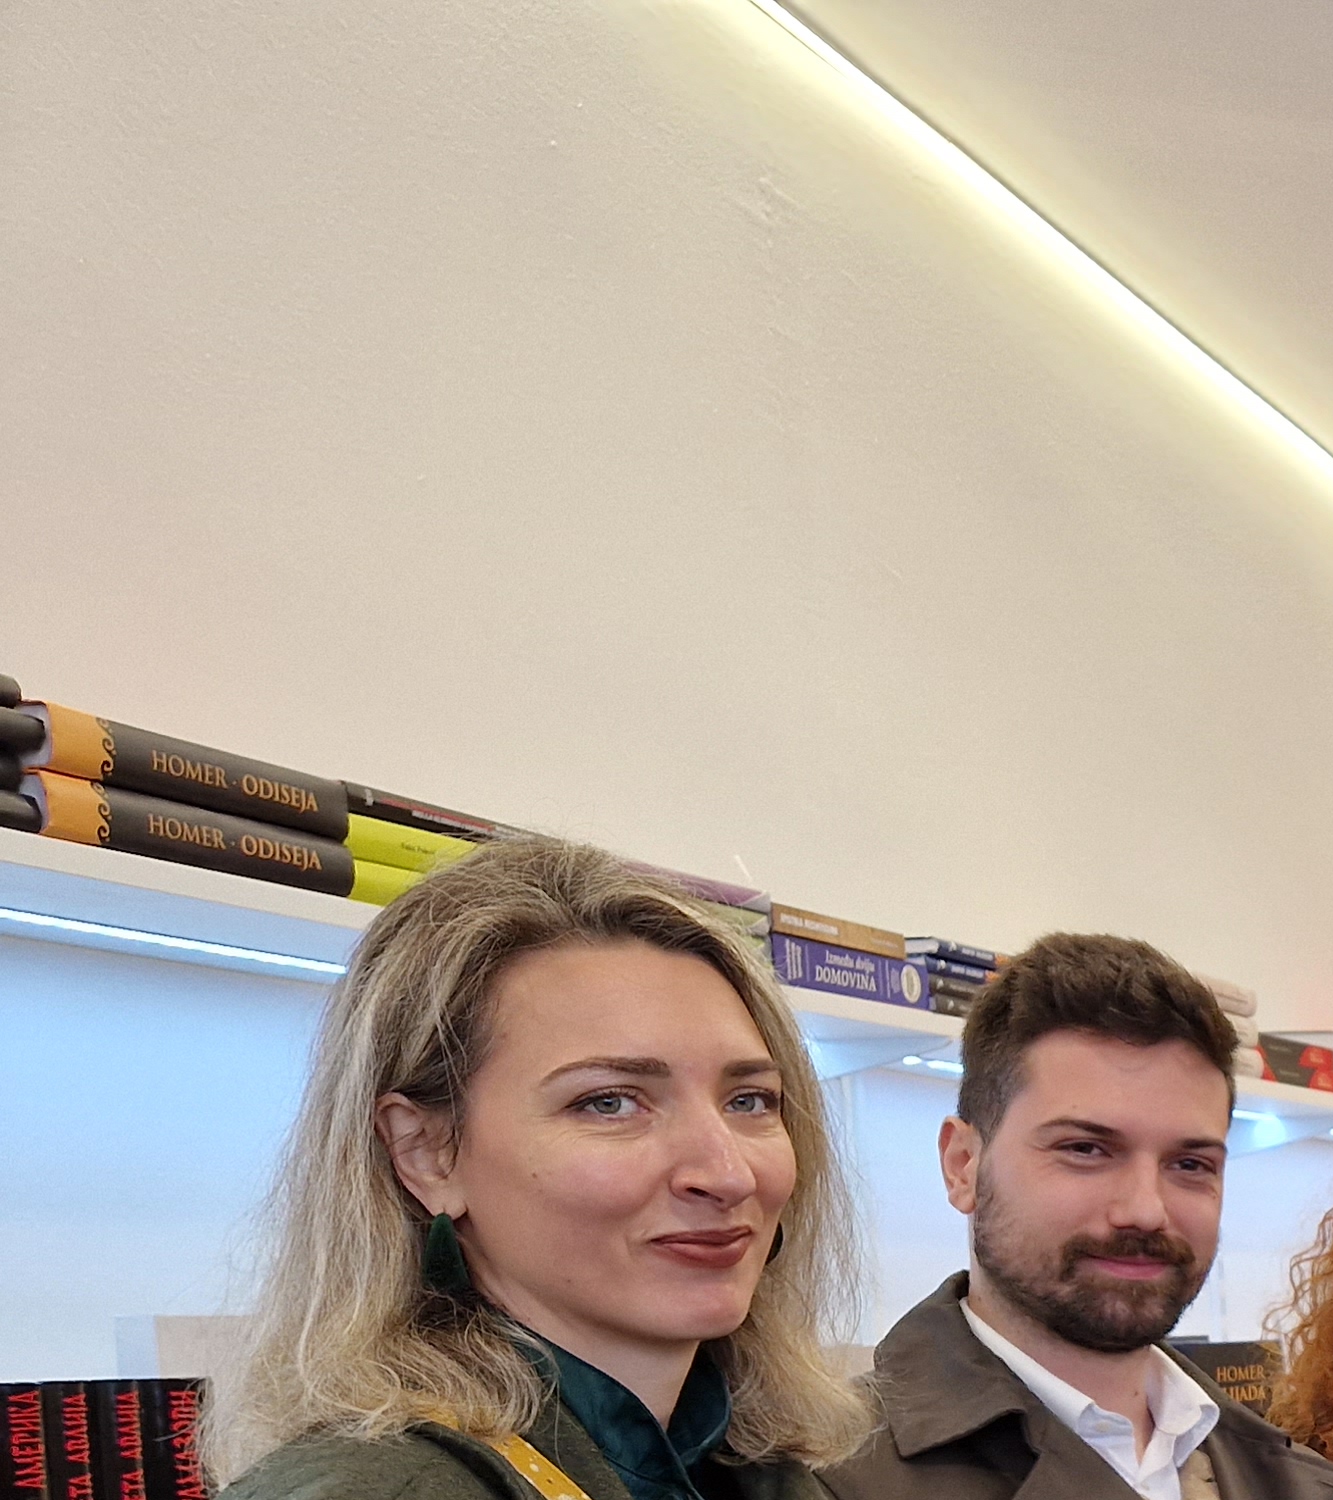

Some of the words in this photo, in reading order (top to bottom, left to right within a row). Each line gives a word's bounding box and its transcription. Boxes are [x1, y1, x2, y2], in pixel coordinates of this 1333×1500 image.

[151, 750, 228, 789] HOMER
[241, 774, 319, 813] ODISEJA
[148, 813, 226, 849] HOMER
[240, 834, 322, 871] ODISEJA
[815, 965, 877, 993] DOMOVINA
[1216, 1364, 1266, 1382] HOMER
[7, 1390, 46, 1489] АМЕРИКА
[62, 1392, 90, 1465] АВЛИЈА
[116, 1391, 142, 1460] АВЛИЈА
